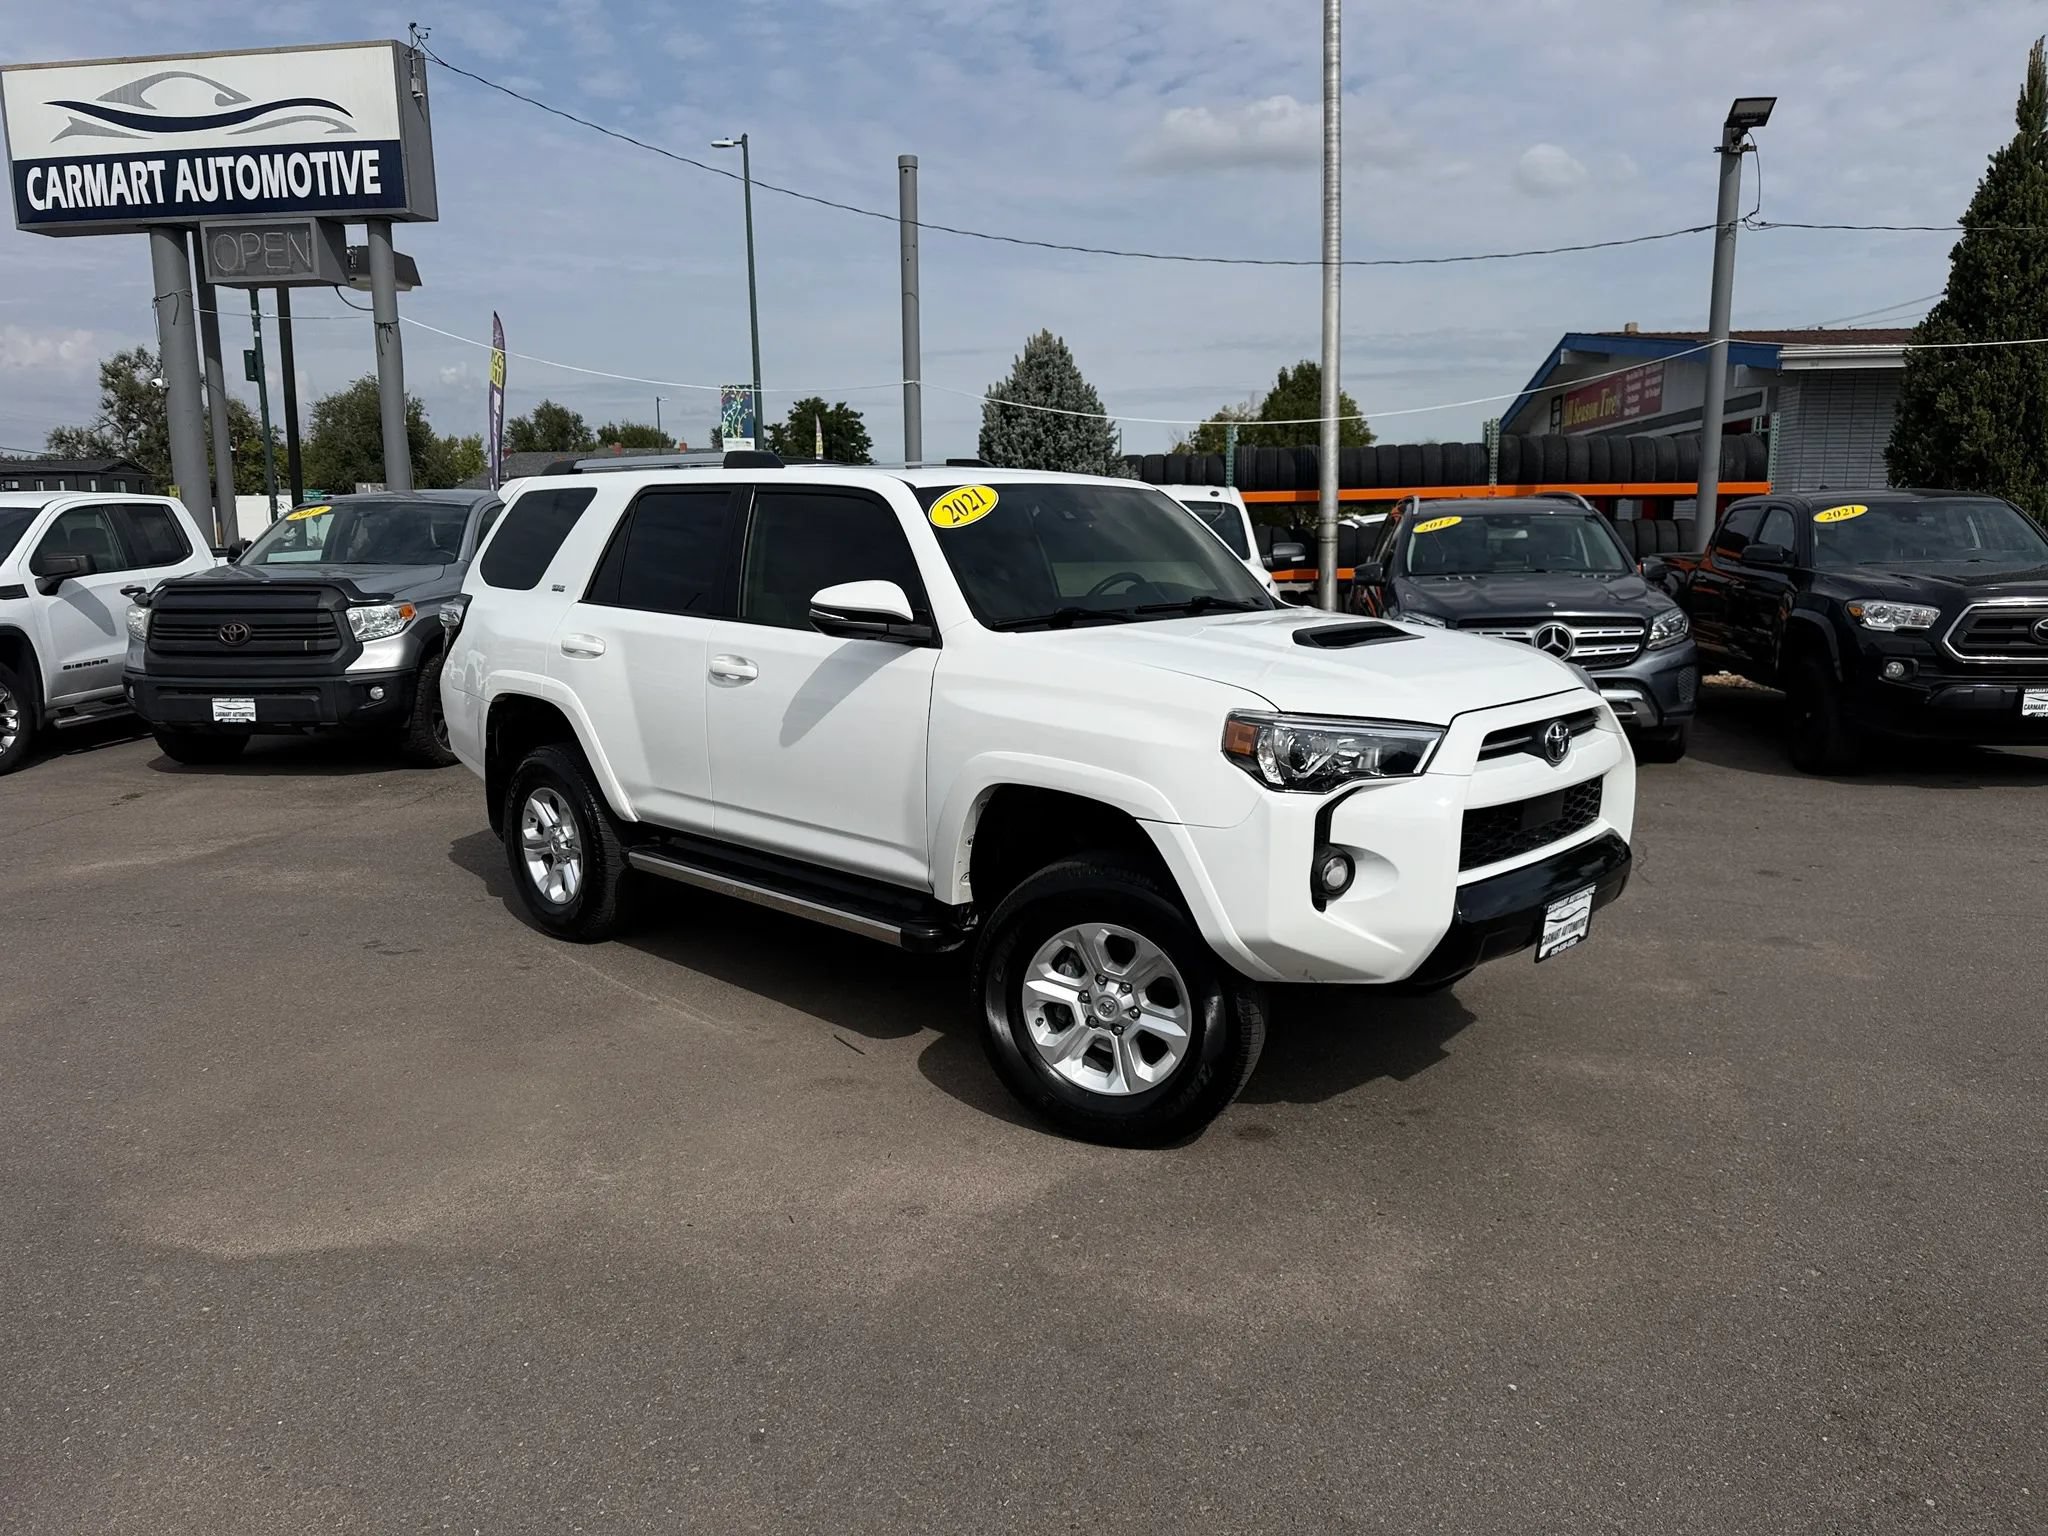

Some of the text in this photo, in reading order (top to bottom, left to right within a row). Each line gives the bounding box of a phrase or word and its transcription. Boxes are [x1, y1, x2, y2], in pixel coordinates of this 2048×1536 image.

[26, 149, 382, 211] CARMART AUTOMOTIVE
[212, 231, 312, 272] OPEN
[942, 488, 987, 523] 2021
[1824, 506, 1856, 520] 2021
[1423, 518, 1453, 531] 2017
[62, 658, 109, 671] SIERRA
[2024, 703, 2047, 711] CARMART
